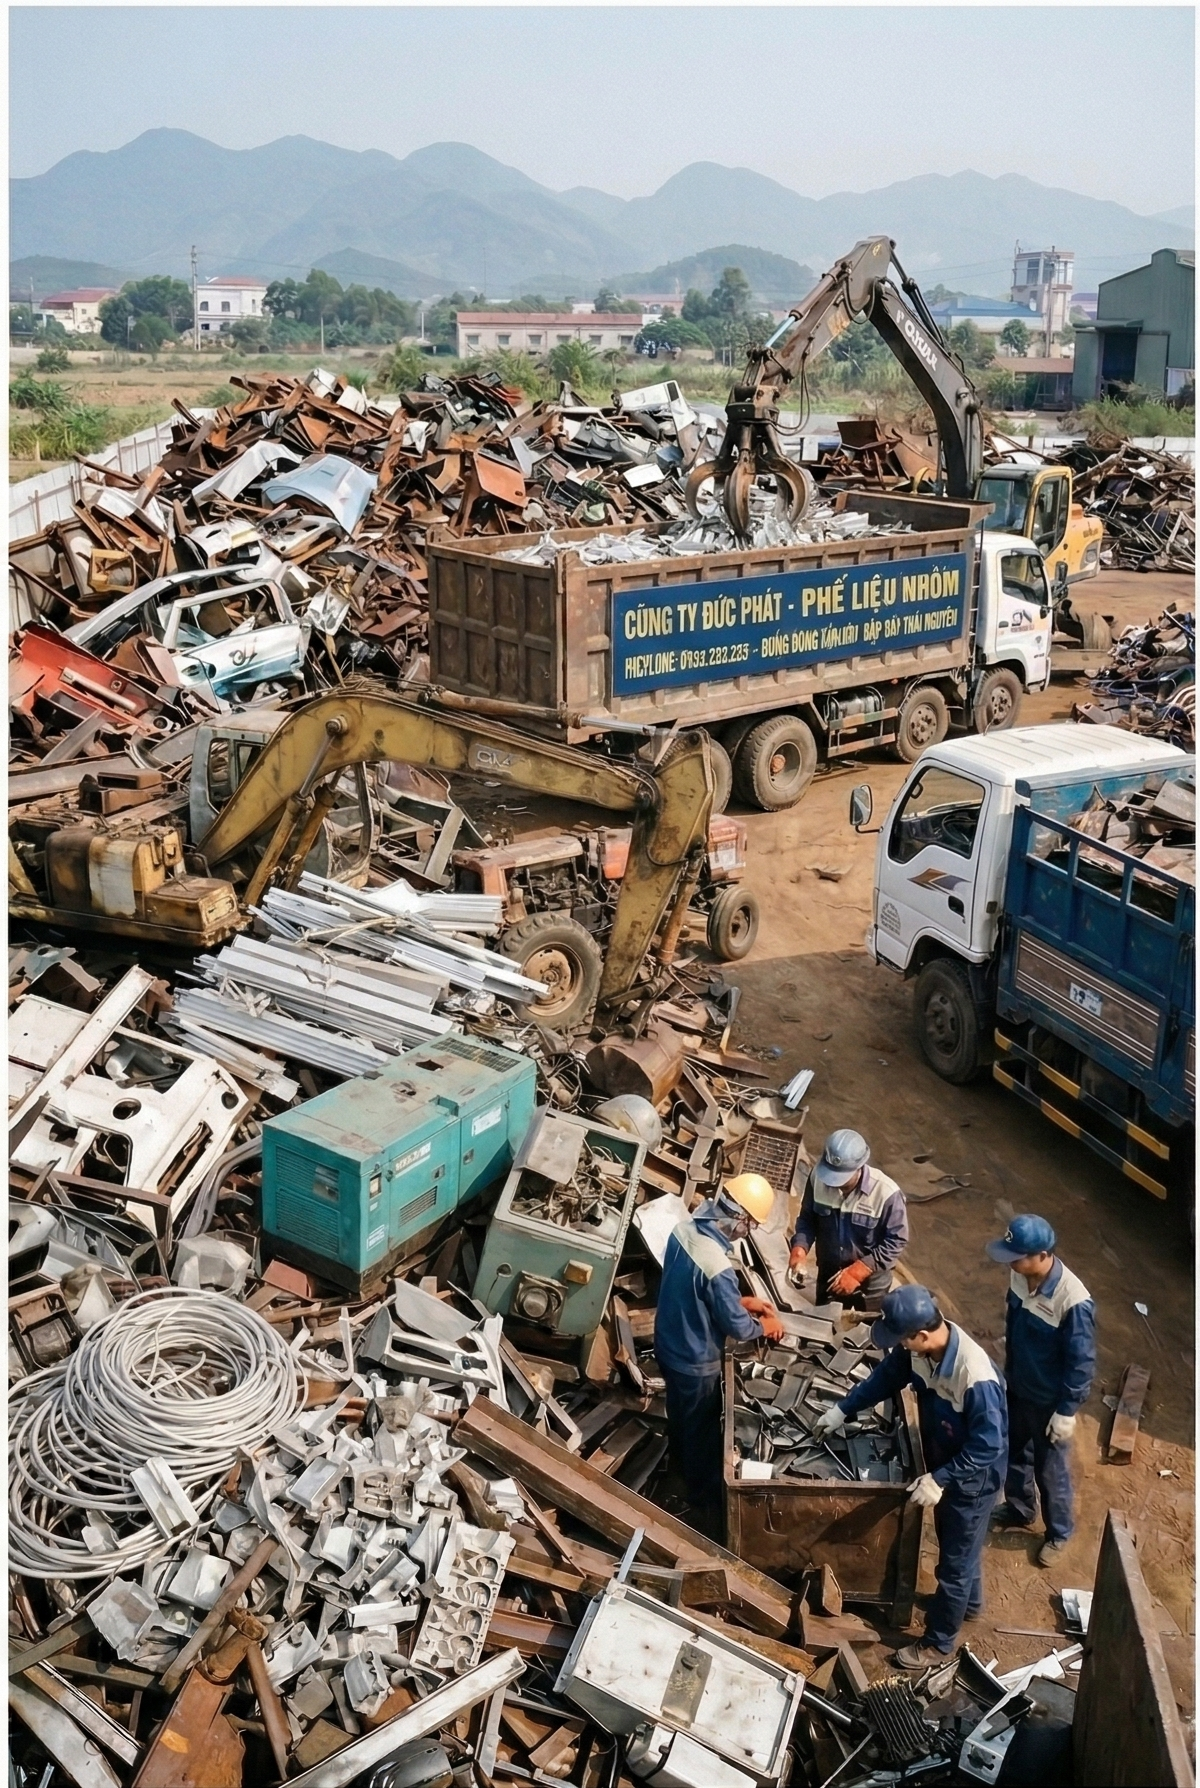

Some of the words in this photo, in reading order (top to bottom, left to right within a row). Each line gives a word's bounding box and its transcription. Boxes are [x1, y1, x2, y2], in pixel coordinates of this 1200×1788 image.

[677, 603, 698, 633] TY
[702, 594, 736, 630] ĐỨC
[741, 587, 782, 625] PHÁT
[802, 573, 849, 618] PHẾ
